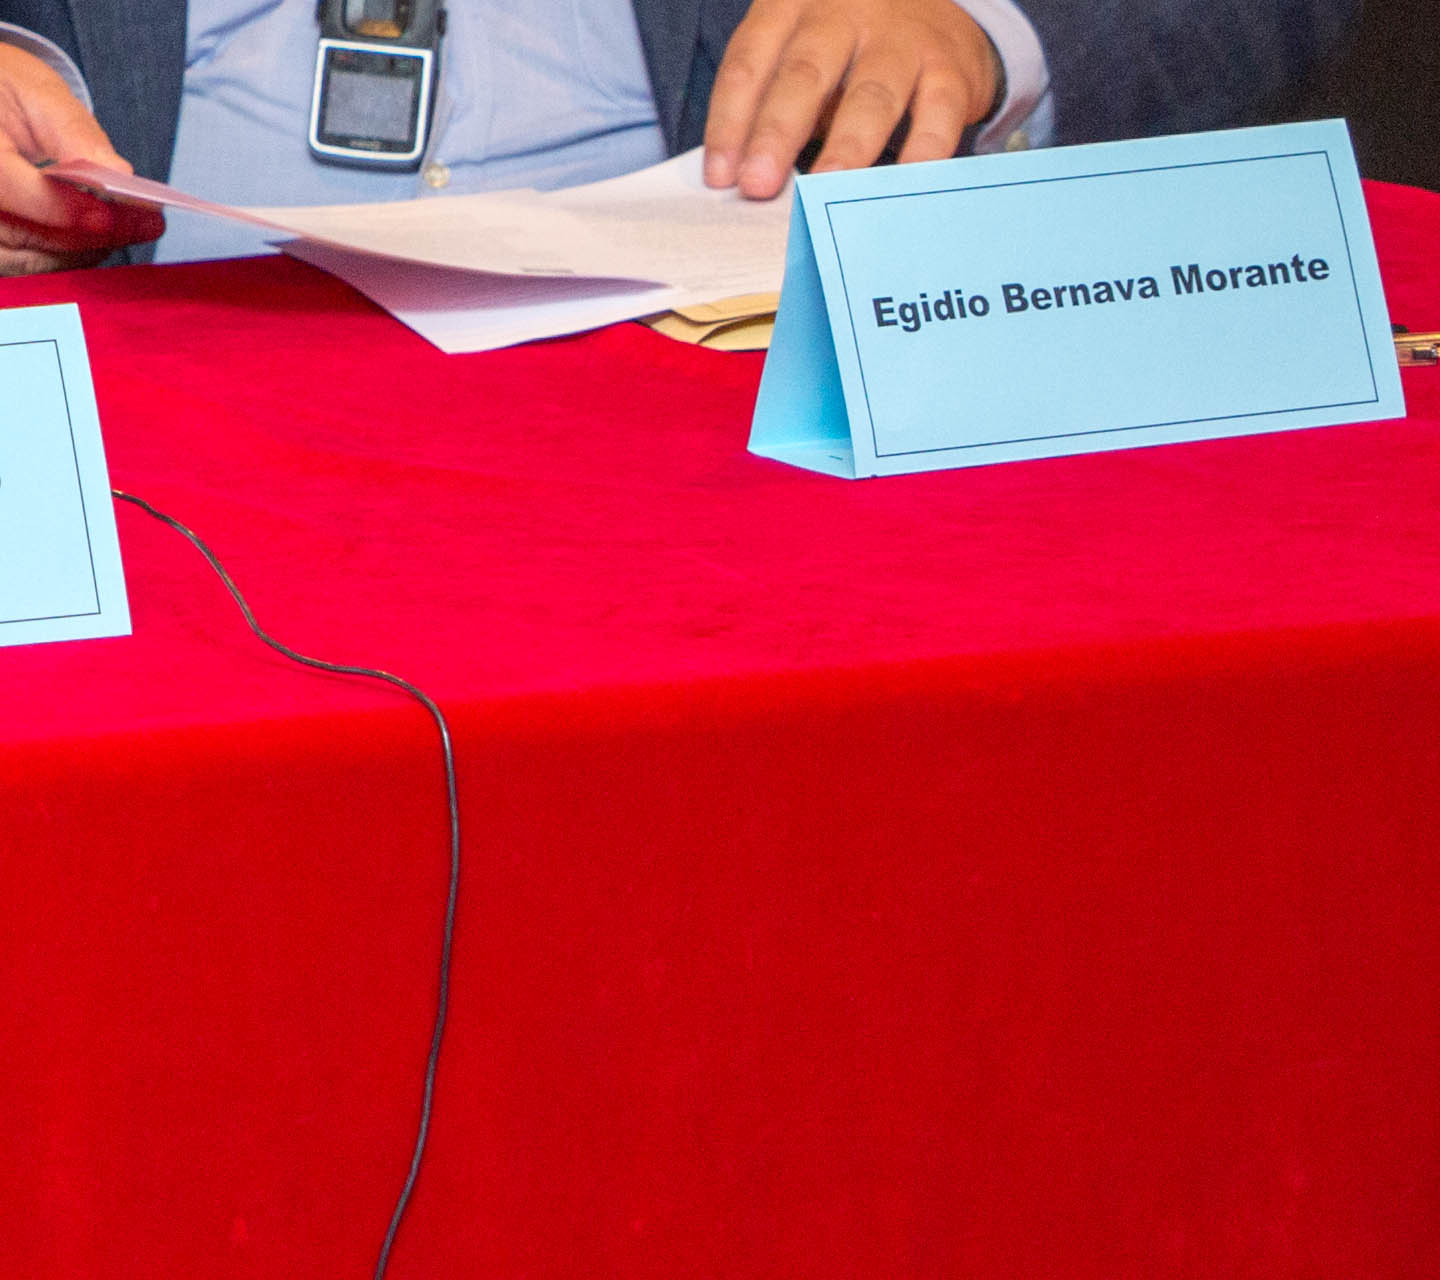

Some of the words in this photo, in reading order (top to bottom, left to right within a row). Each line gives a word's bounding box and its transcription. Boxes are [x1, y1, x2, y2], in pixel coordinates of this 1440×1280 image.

[872, 290, 990, 333] Egidio
[1001, 277, 1162, 314] Bernava
[1169, 253, 1331, 296] Morante
